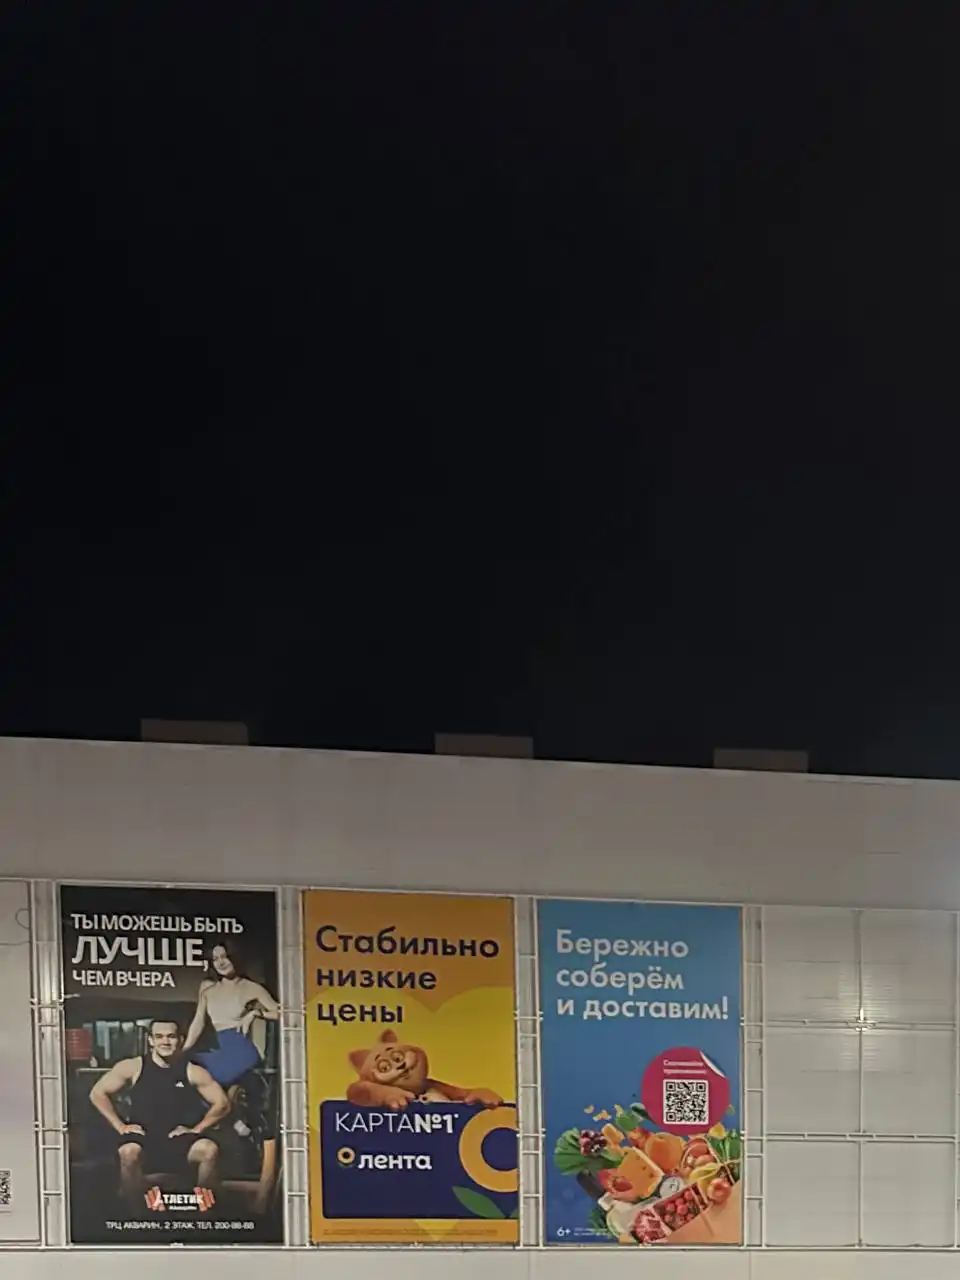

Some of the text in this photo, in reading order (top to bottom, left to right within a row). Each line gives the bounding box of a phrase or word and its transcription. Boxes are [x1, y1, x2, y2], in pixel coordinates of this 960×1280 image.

[70, 913, 244, 934] ТЫ МОЖЕШЬ БЫТЬ
[316, 924, 500, 958] Стабильно
[556, 928, 689, 962] Бережно
[71, 935, 209, 972] ЛУЧШЕ,
[72, 969, 176, 988] ЧЕМ ВЧЕРА
[316, 968, 437, 990] низкие
[556, 961, 685, 996] соберём
[317, 1002, 403, 1026] цены
[557, 996, 729, 1021] и доставим!
[358, 1154, 433, 1170] лента
[556, 1226, 571, 1237] 6+
